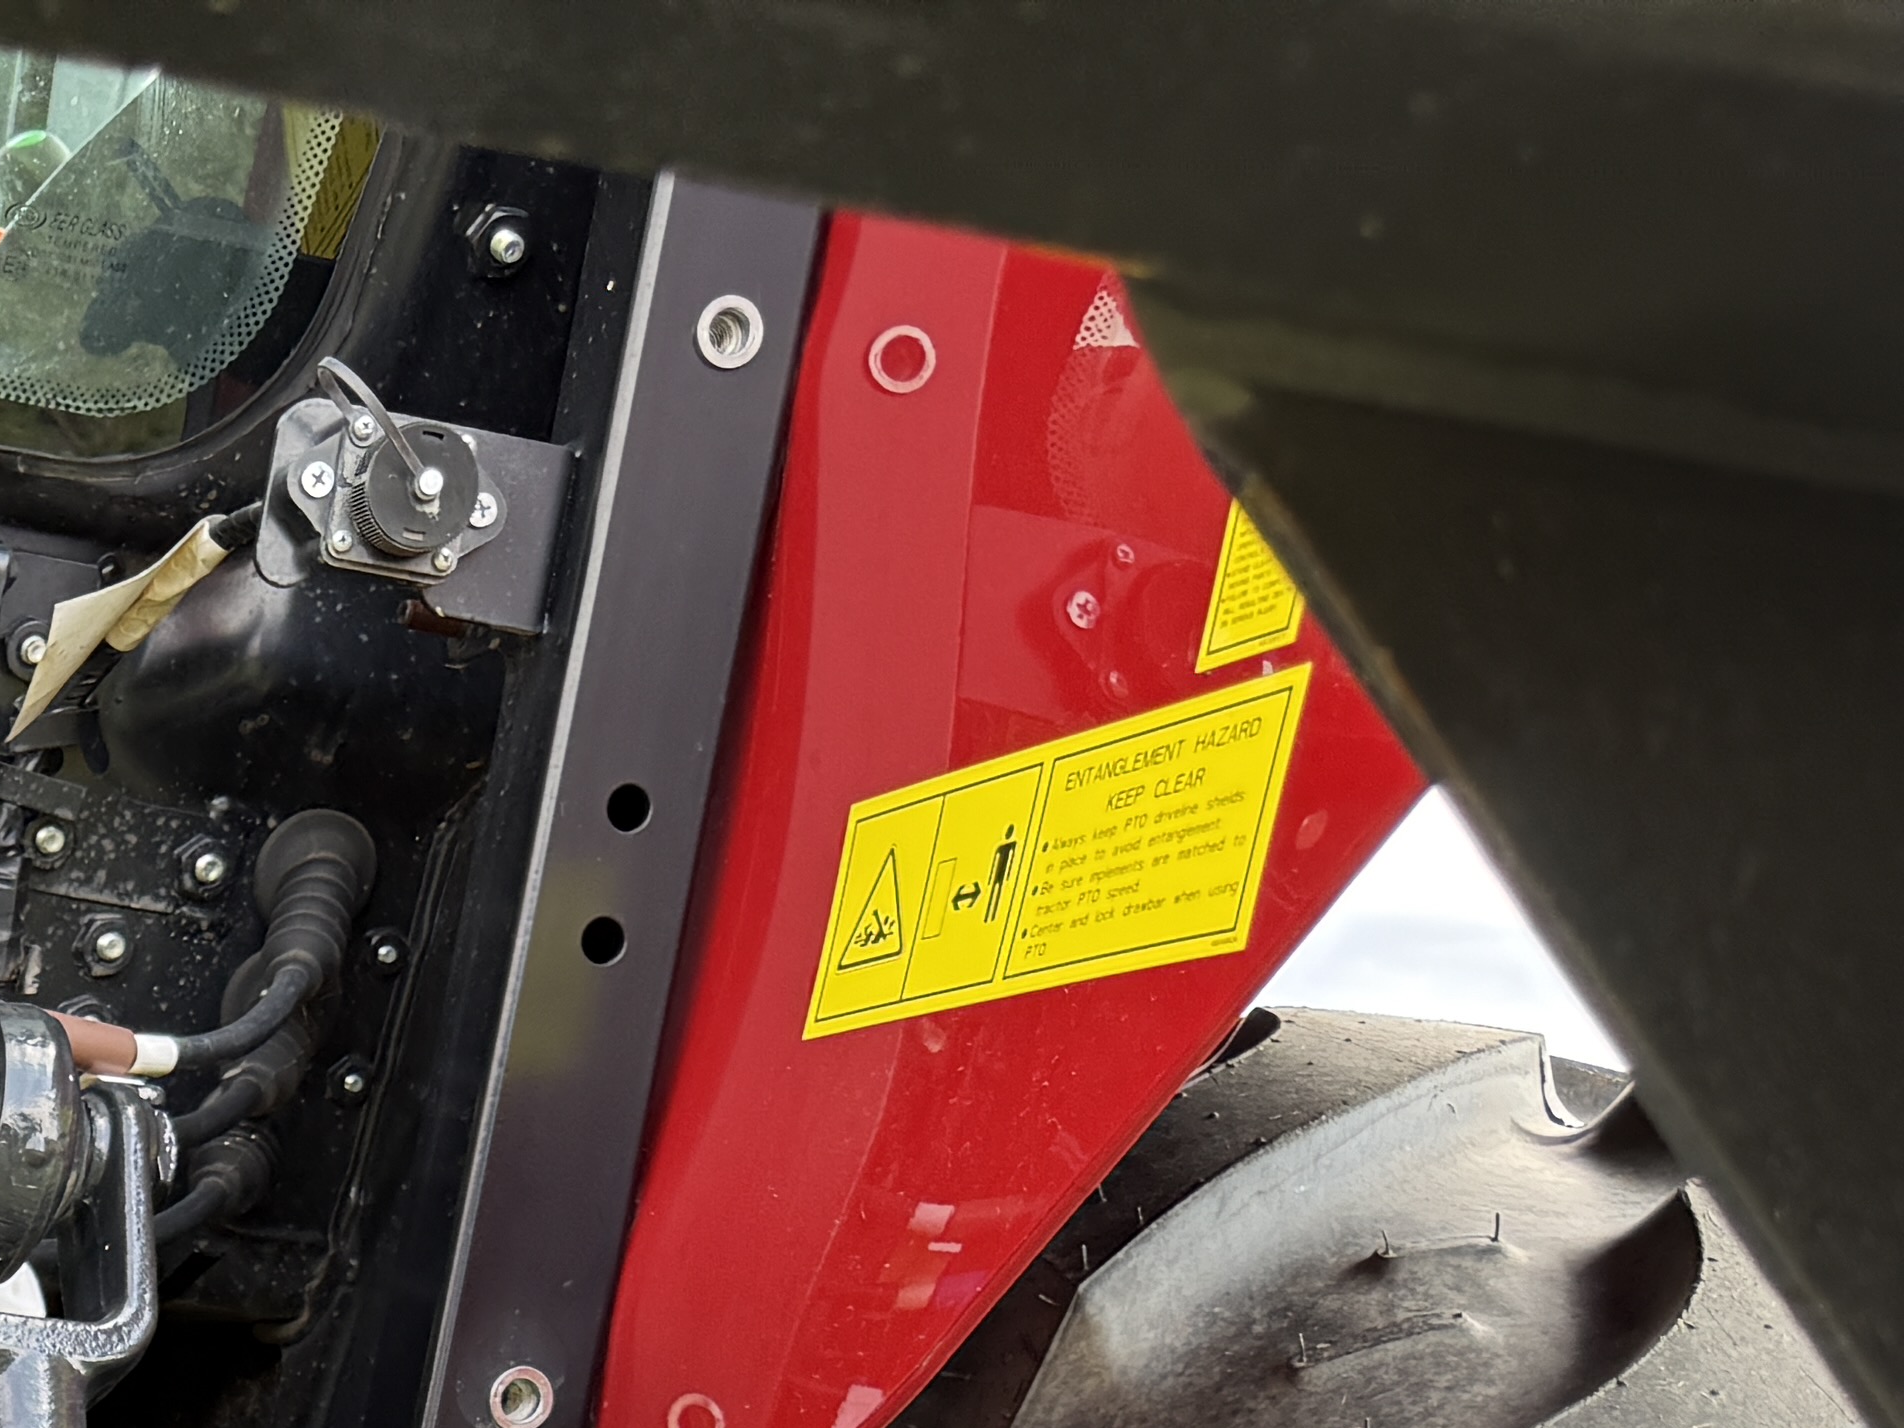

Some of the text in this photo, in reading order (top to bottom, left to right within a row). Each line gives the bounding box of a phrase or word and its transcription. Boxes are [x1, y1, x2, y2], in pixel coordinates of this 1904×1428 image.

[1063, 714, 1264, 792] ENTANGLEMENT HAZARD
[1104, 765, 1207, 812] KEEP CLEAR
[1049, 830, 1088, 854] Always
[1090, 822, 1118, 844] keep
[1122, 812, 1149, 833] PTO
[1058, 853, 1088, 874] place
[1093, 846, 1106, 862] to
[1110, 837, 1142, 857] avoid
[1038, 878, 1055, 896] Be
[1059, 875, 1083, 891] sure
[1150, 854, 1170, 868] are
[1175, 837, 1226, 862] matched
[1231, 832, 1248, 848] to
[1028, 878, 1240, 939] Center and lock drawbar when using
[1076, 887, 1101, 906] PTO
